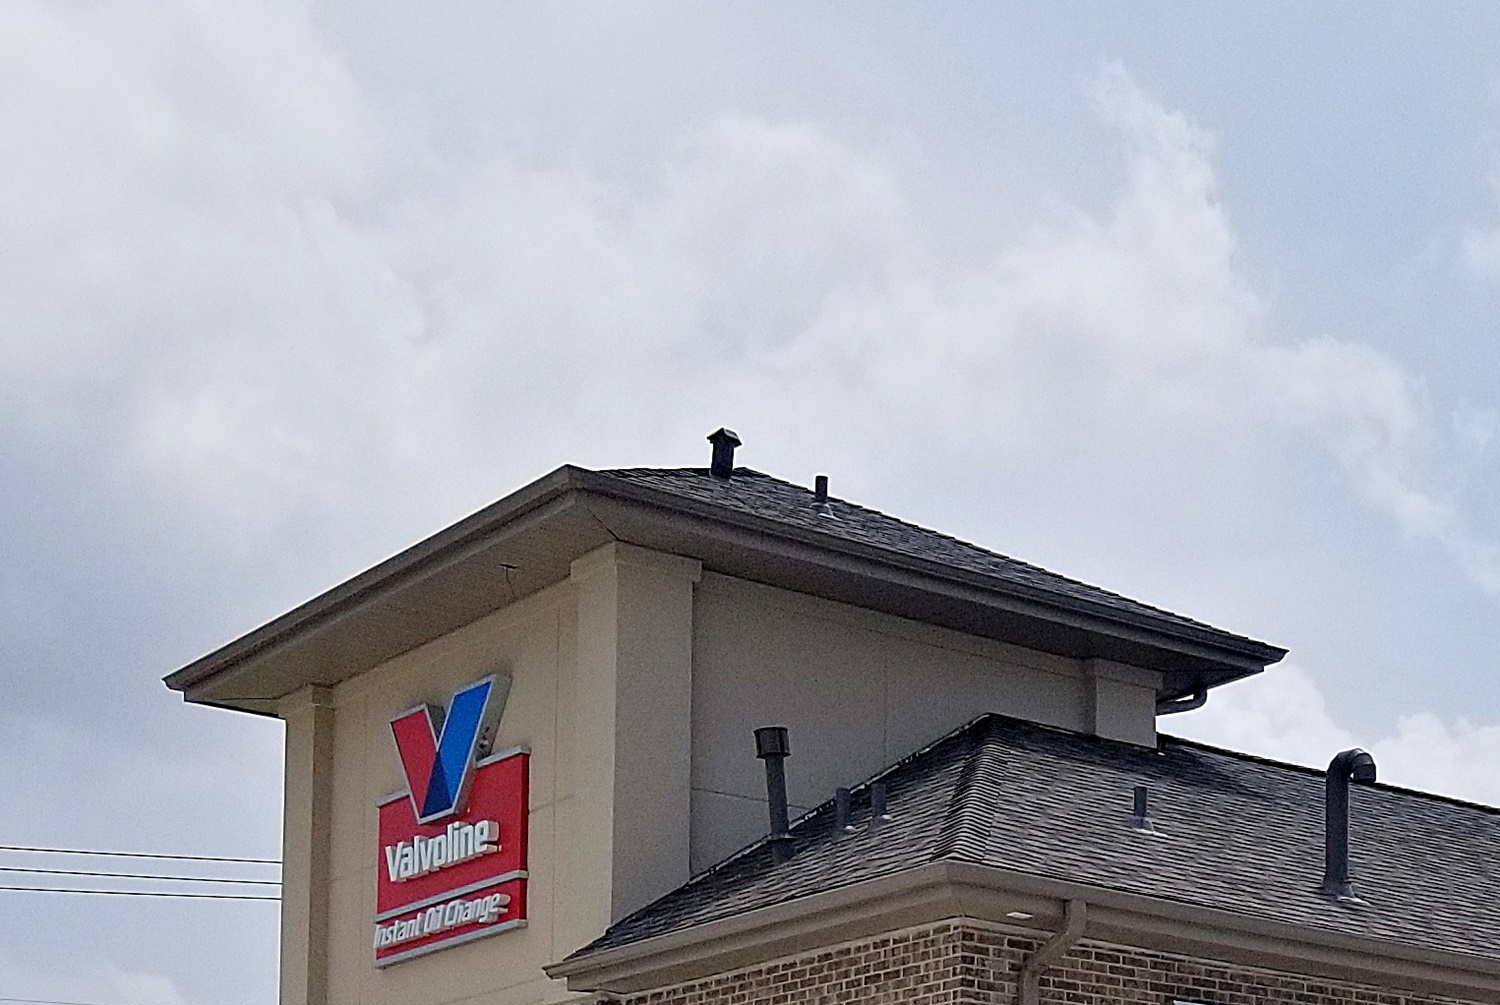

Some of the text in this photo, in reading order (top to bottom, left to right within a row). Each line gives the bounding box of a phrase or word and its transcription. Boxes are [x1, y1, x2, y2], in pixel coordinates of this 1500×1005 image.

[385, 819, 499, 882] Valvoline
[373, 893, 509, 948] Instant Oil Change
